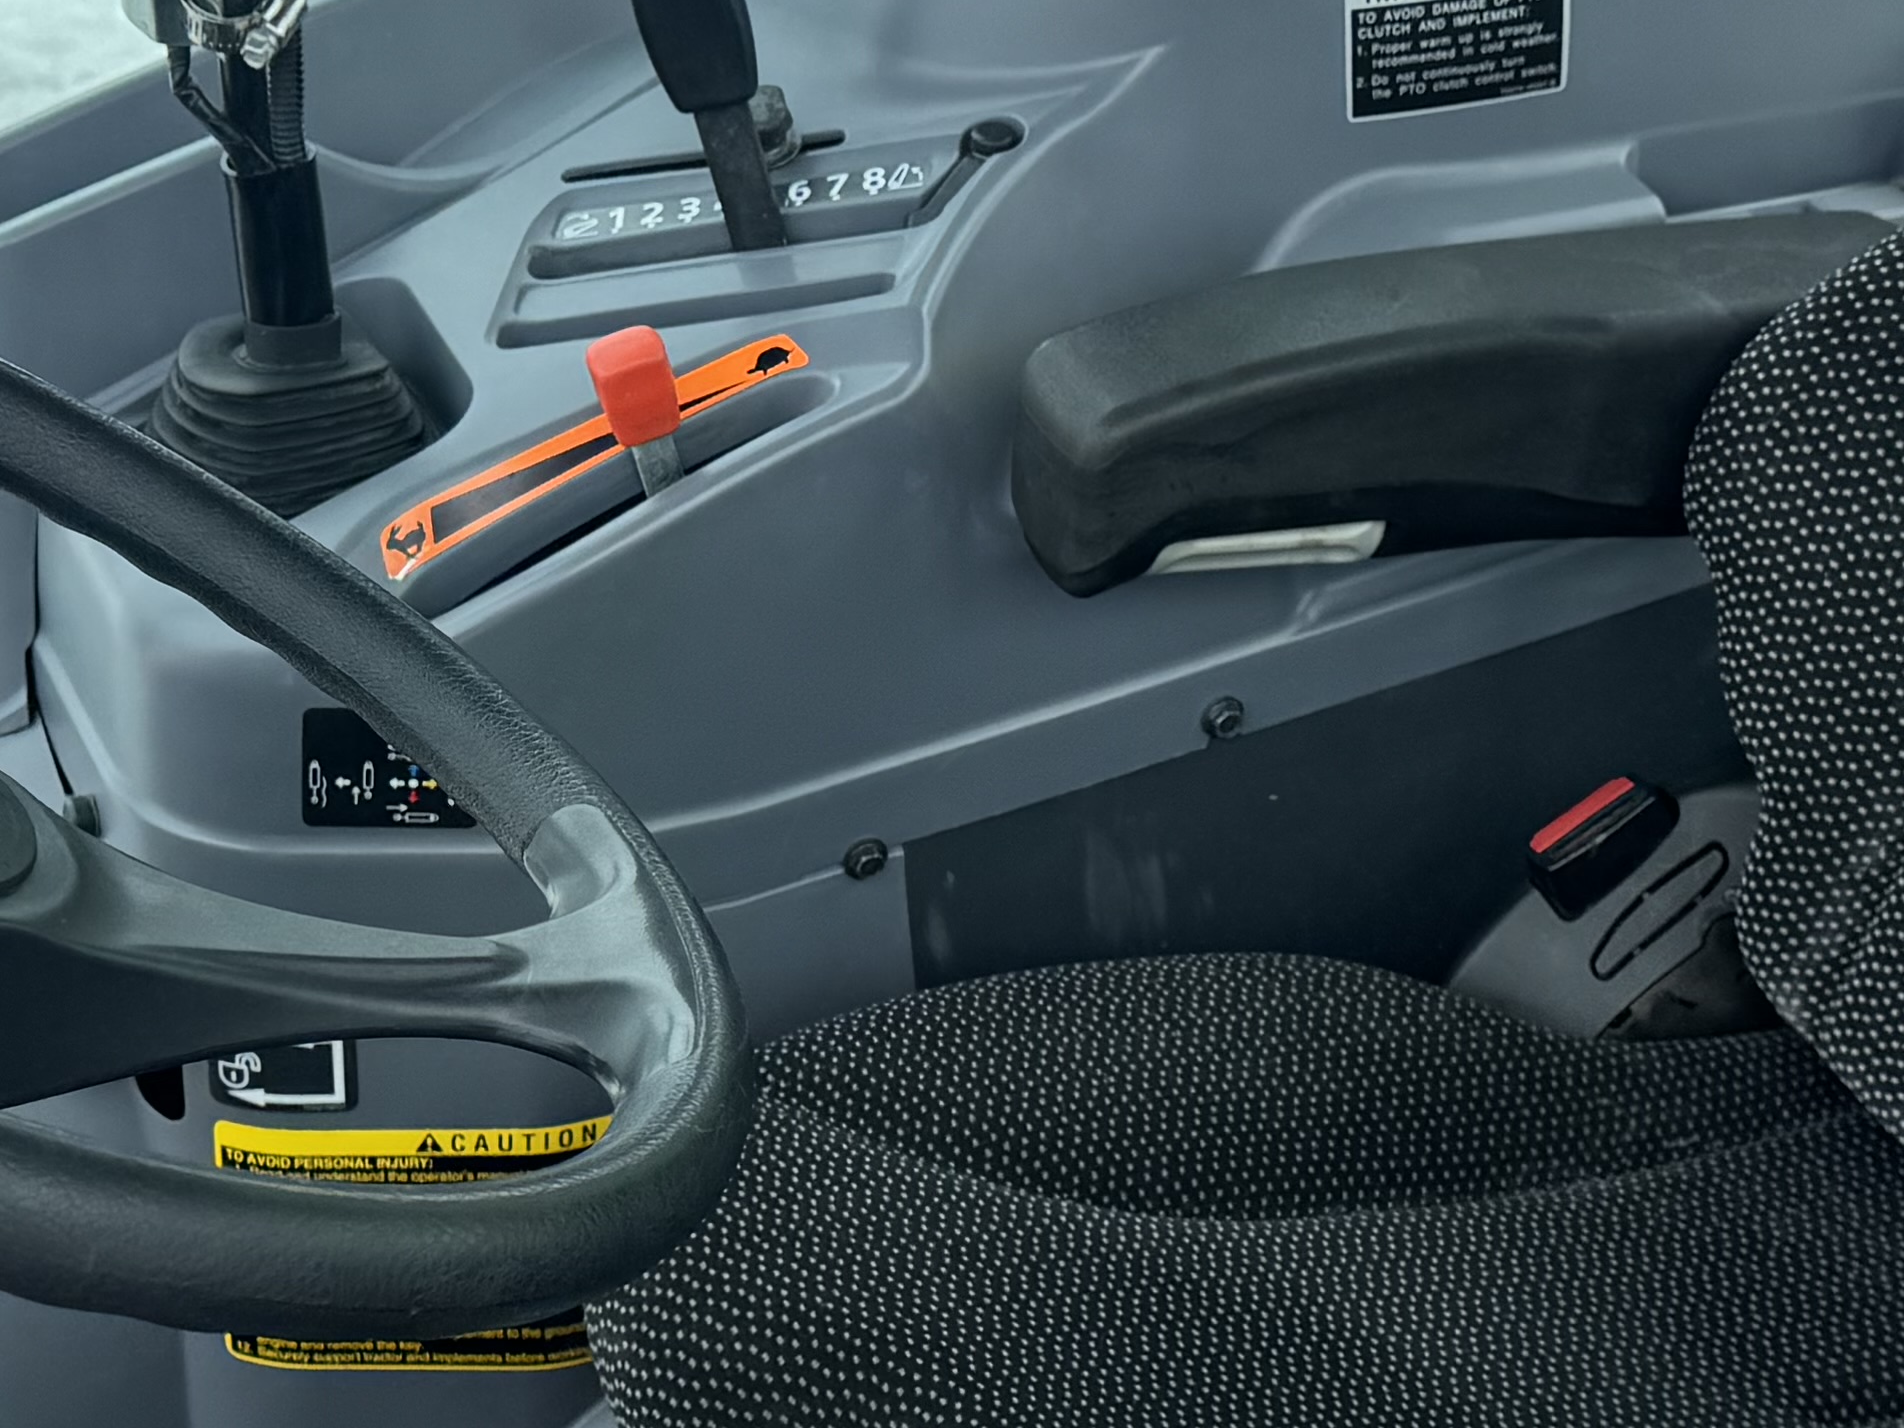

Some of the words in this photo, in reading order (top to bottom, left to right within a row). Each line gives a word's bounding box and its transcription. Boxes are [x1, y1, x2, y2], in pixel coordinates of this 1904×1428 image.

[1357, 12, 1377, 25] TO
[1383, 5, 1425, 22] AVOID
[1357, 22, 1411, 40] CLUTCH
[1418, 18, 1446, 32] AND
[1357, 45, 1368, 57] 1.
[1371, 37, 1413, 56] Proper
[1419, 35, 1452, 50] warm
[1458, 32, 1474, 45] up
[1480, 29, 1492, 42] is
[1371, 47, 1456, 70] recommended
[1462, 44, 1475, 57] in
[1480, 38, 1505, 54] cold
[1371, 74, 1389, 88] Do
[1395, 70, 1417, 84] not
[1422, 60, 1496, 80] continuously
[1502, 55, 1526, 69] turn
[1372, 86, 1393, 100] the
[1399, 83, 1427, 97] PTO
[1432, 77, 1469, 94] clutch
[1474, 70, 1516, 88] control
[609, 207, 625, 229] 1
[641, 203, 663, 225] 2
[678, 197, 701, 218] 3
[787, 180, 812, 203] 6
[826, 174, 849, 196] 7
[863, 167, 887, 190] 8
[451, 1123, 597, 1152] CAUTION
[226, 1148, 244, 1163] TO
[247, 1153, 291, 1169] AVOID
[294, 1158, 373, 1170] PERSONAL
